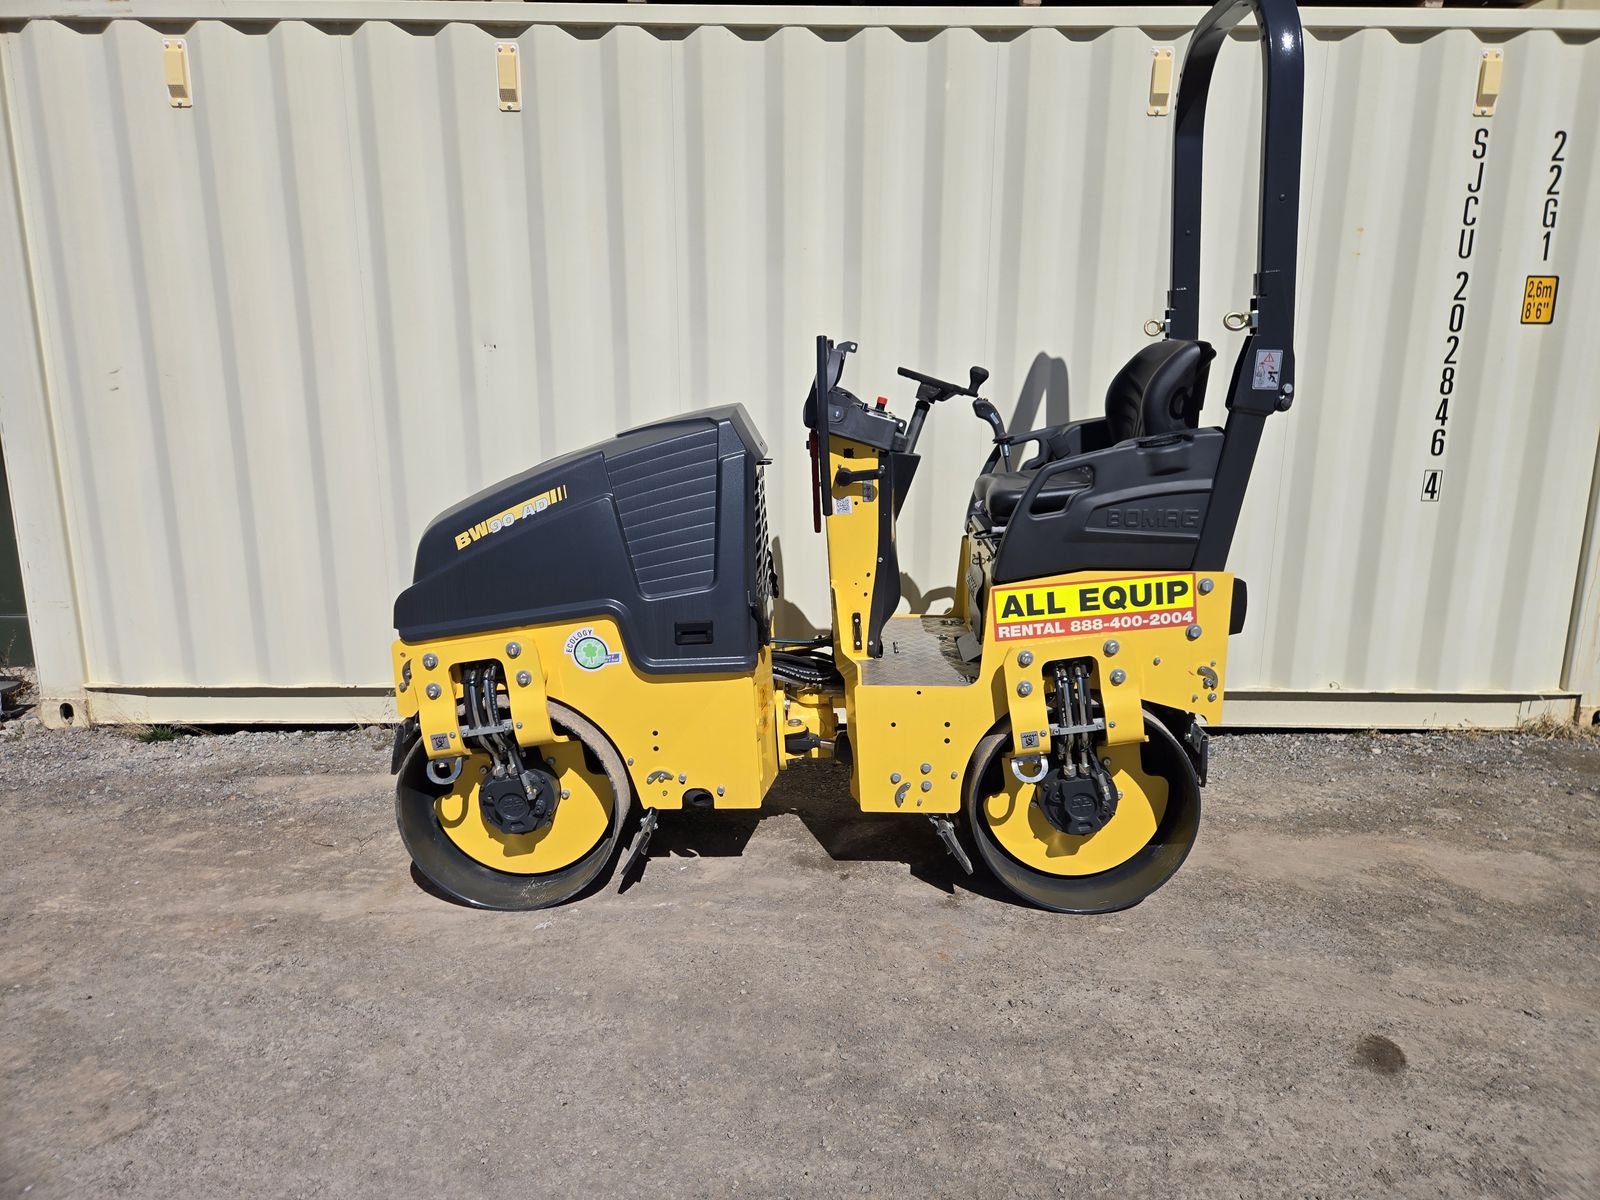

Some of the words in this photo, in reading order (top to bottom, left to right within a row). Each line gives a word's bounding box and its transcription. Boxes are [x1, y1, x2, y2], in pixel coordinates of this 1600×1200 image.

[1458, 128, 1489, 260] SJCU
[1541, 130, 1567, 262] 22G1
[1430, 271, 1469, 457] 202846
[1424, 473, 1438, 500] 4
[1106, 508, 1200, 529] BOMAG
[1001, 591, 1066, 619] ALL
[1078, 580, 1189, 612] EQUIP
[566, 629, 593, 653] ECOLOGY
[998, 622, 1065, 639] RENTAL
[1070, 611, 1194, 632] 888-400-2004
